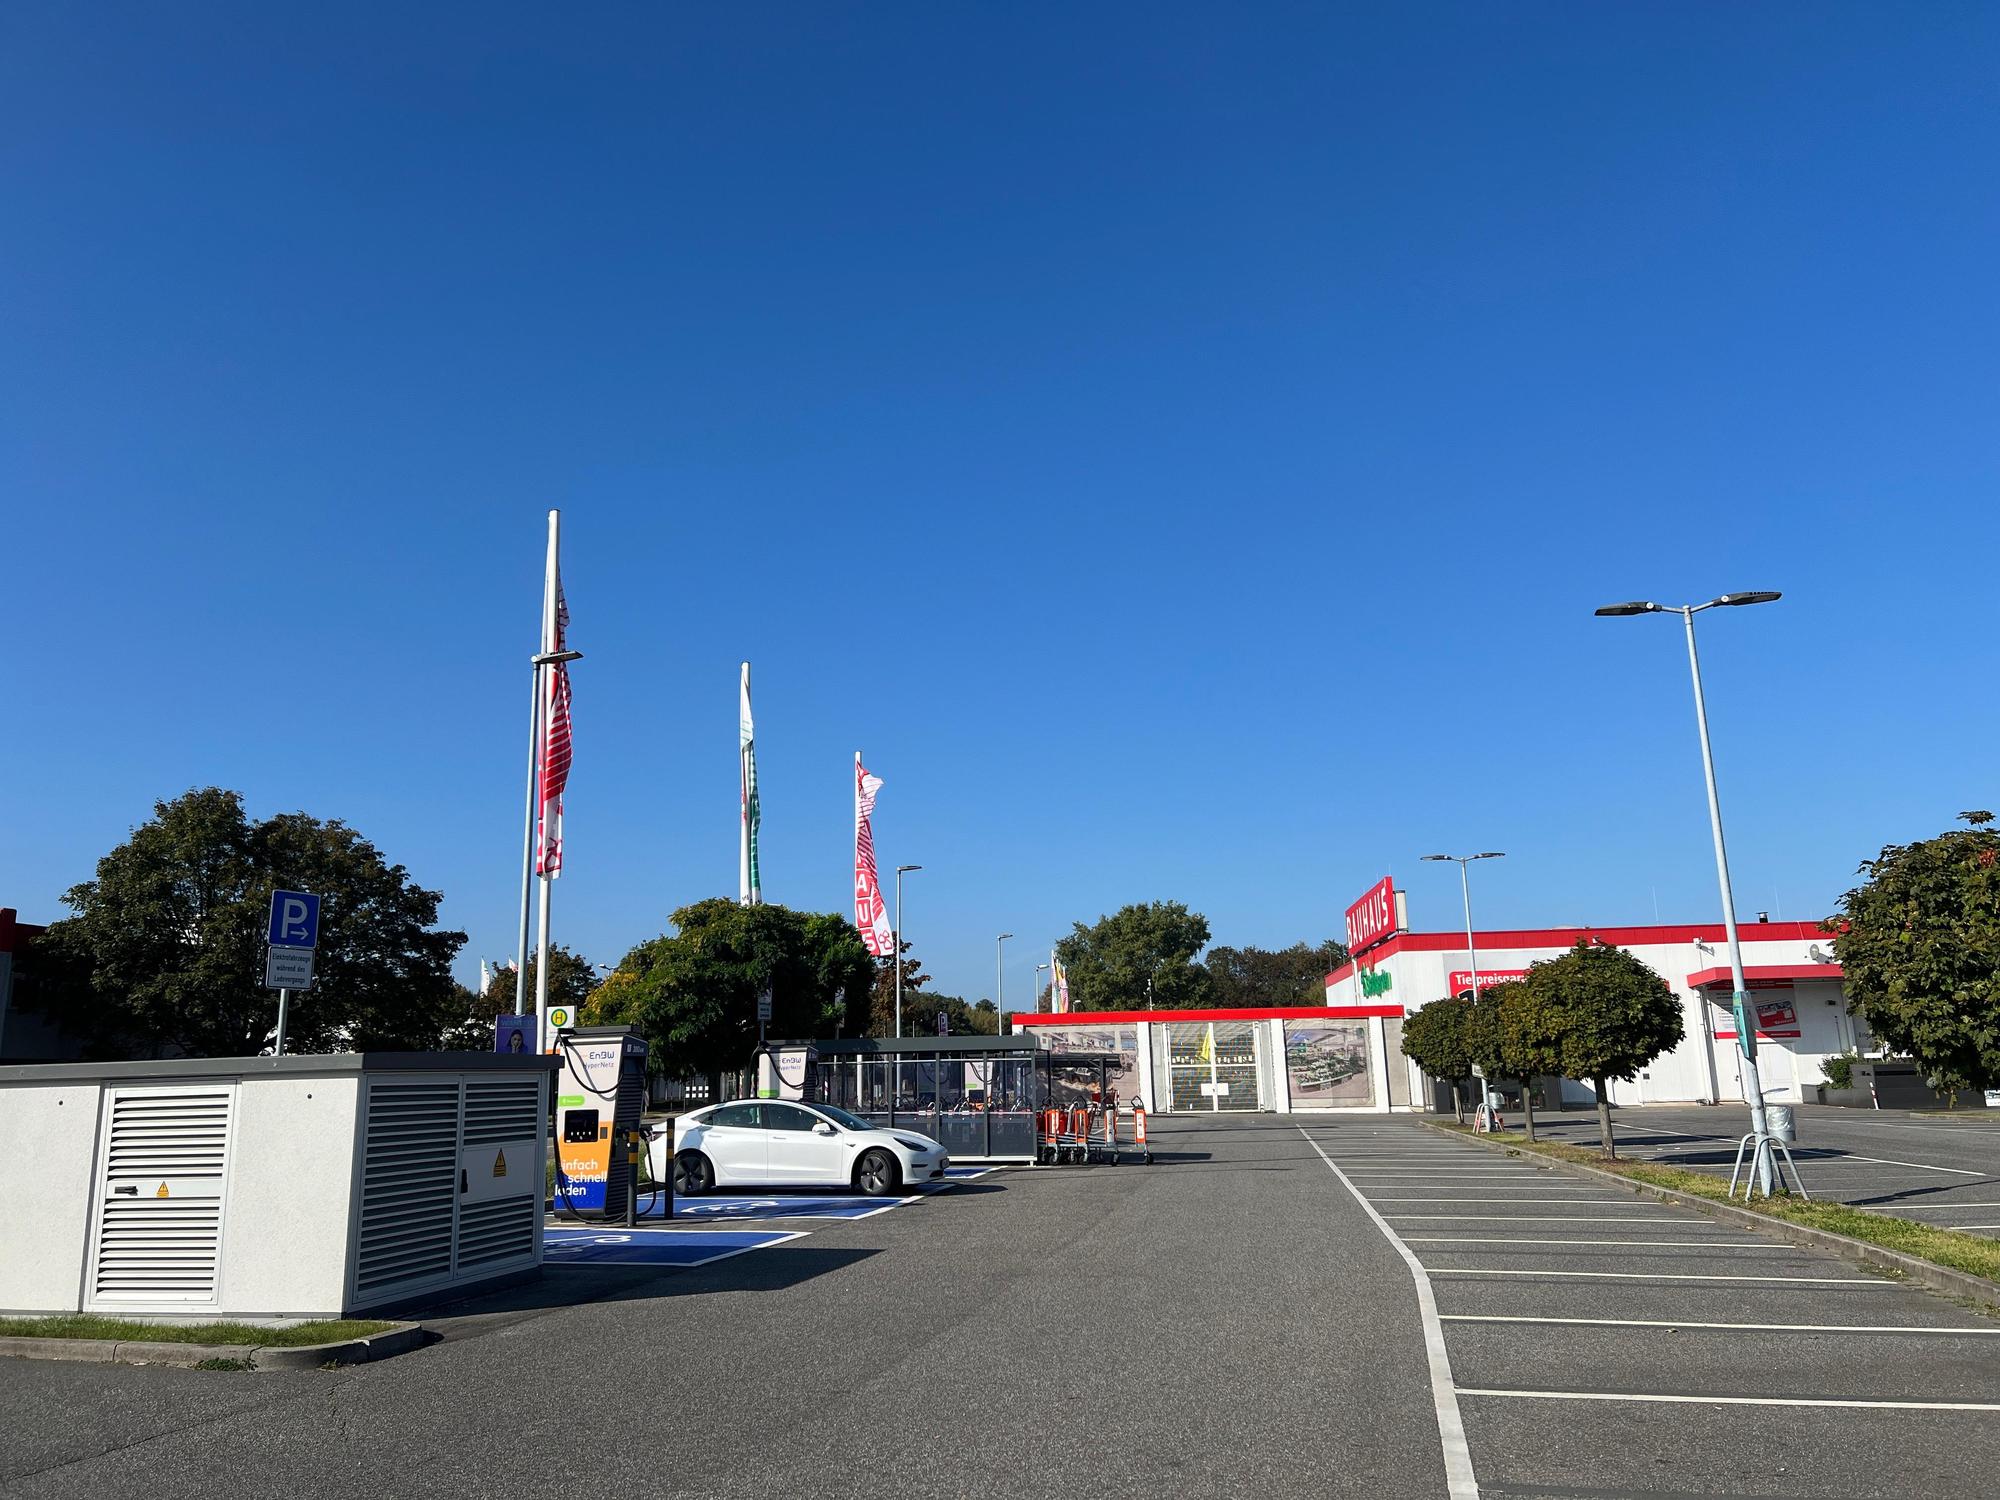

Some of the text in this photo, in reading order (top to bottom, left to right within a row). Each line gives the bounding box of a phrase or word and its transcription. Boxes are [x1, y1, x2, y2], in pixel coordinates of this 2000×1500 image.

[280, 898, 308, 939] P
[1346, 887, 1389, 949] BAUHAUS
[555, 1012, 563, 1024] H
[589, 1051, 615, 1060] EnBW
[567, 1170, 608, 1183] schnell
